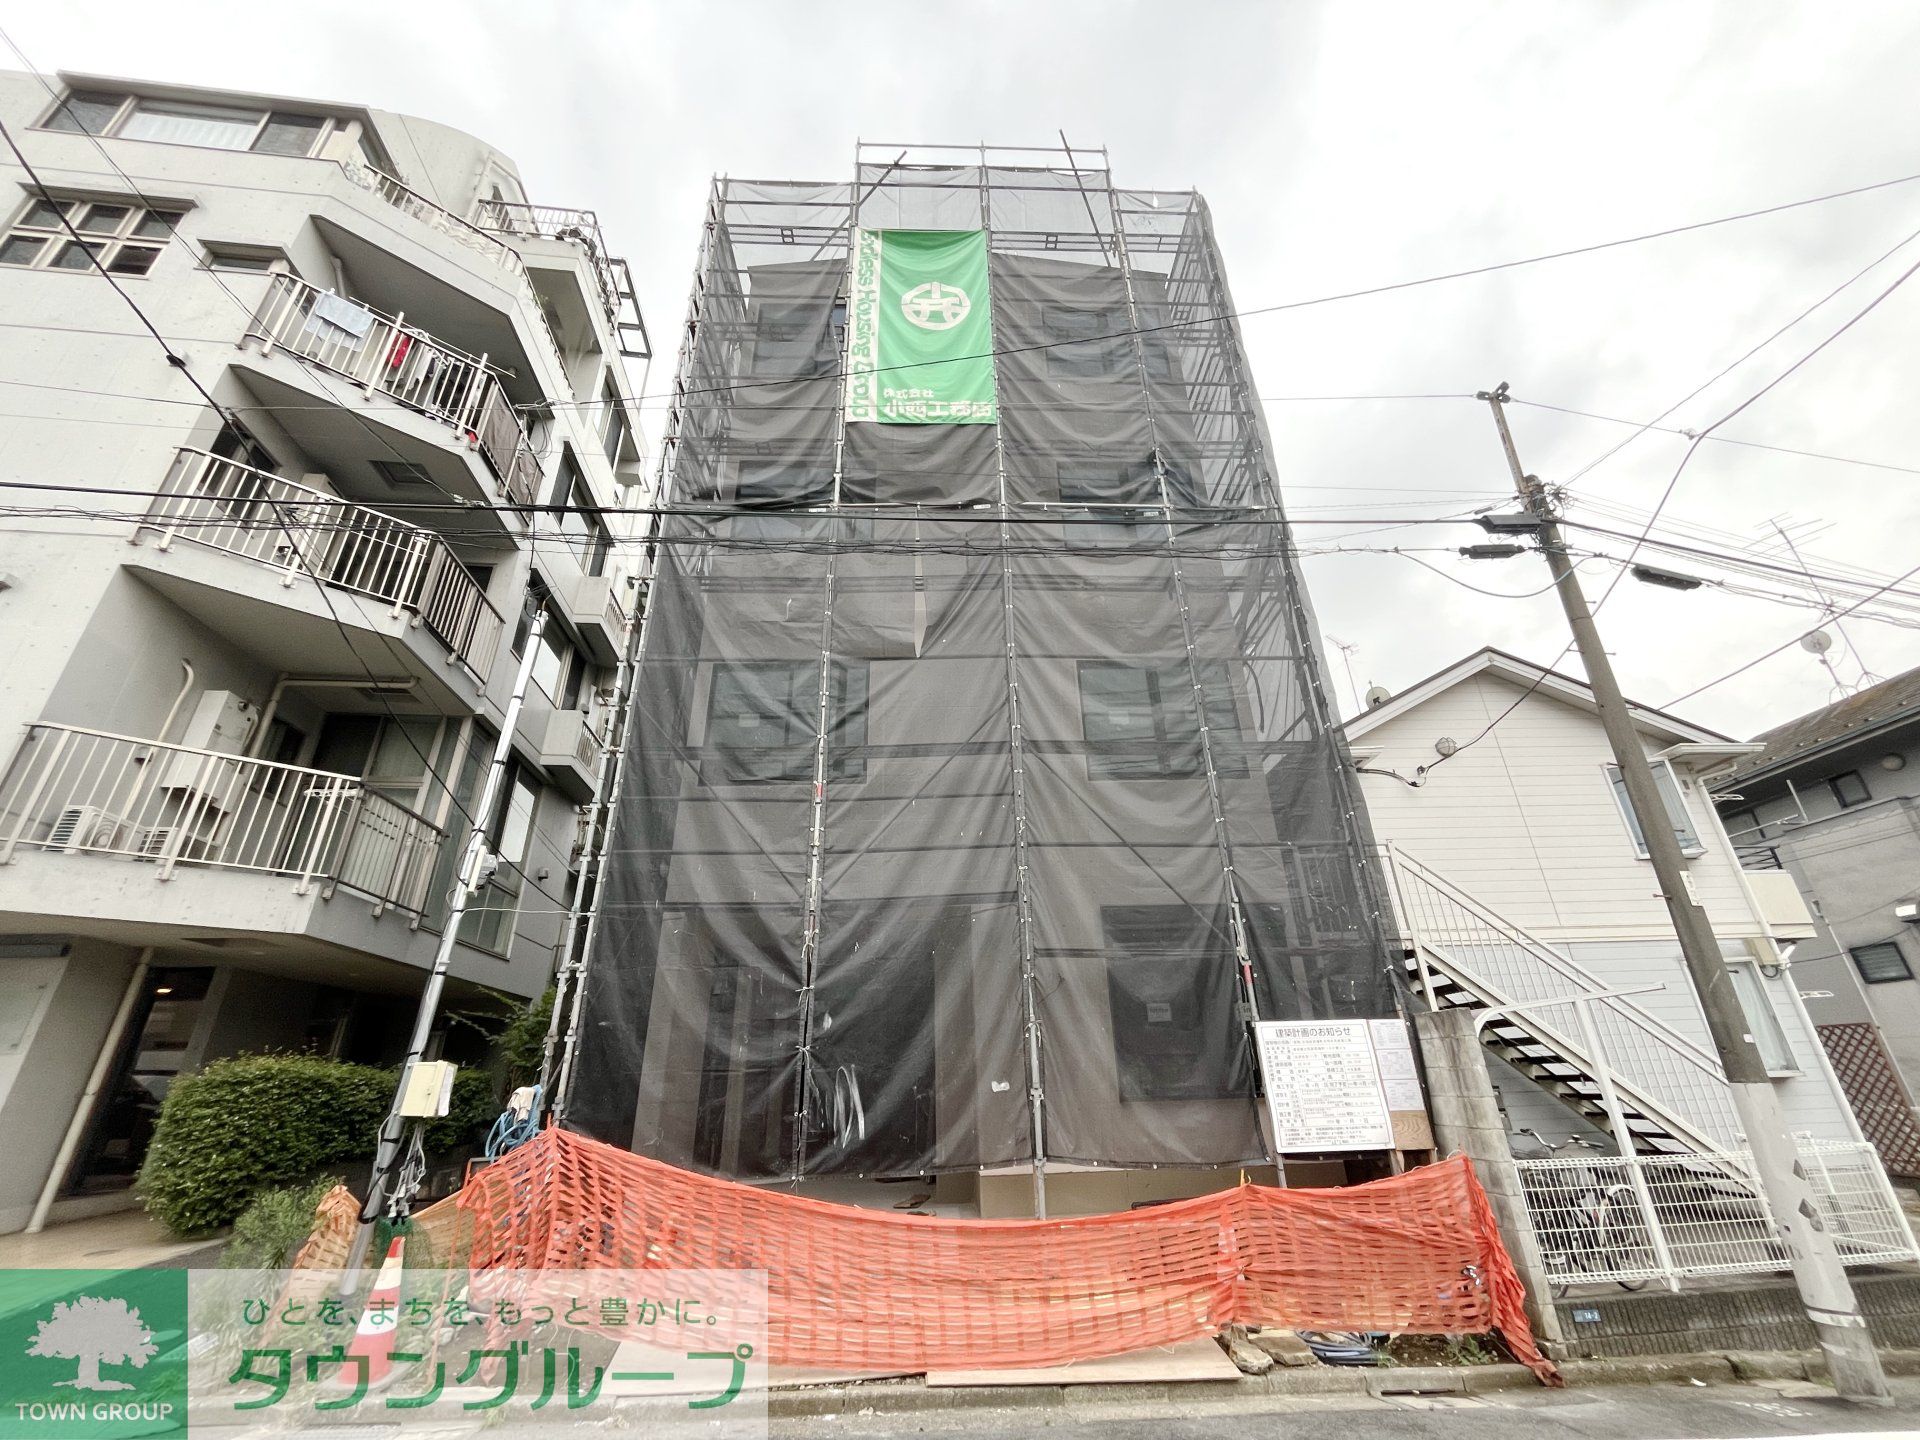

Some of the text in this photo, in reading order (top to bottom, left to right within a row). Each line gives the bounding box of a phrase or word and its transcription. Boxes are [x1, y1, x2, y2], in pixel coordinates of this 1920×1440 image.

[851, 289, 877, 358] Housing
[1275, 1027, 1351, 1038] 建築計画のお知らせ
